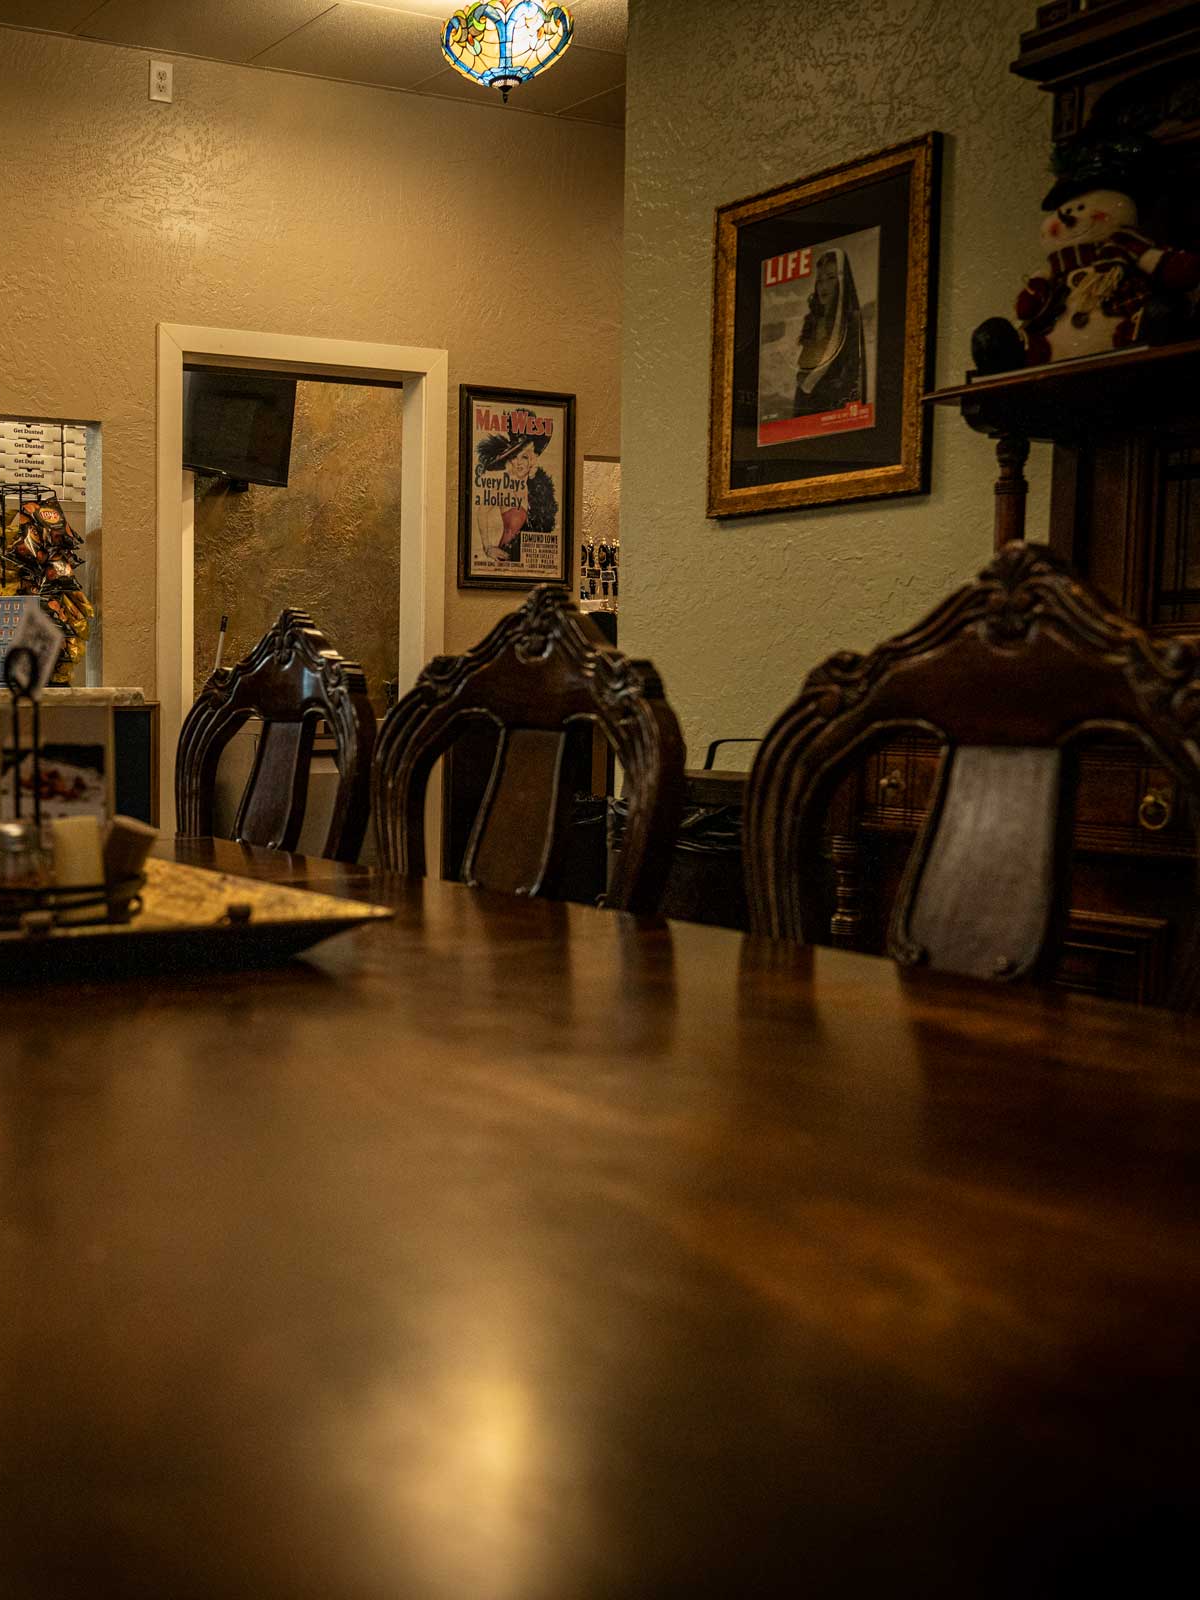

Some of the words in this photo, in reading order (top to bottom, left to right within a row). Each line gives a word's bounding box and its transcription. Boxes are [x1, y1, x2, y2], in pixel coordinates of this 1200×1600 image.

[766, 248, 811, 285] LIFE
[511, 410, 554, 437] WEST
[483, 490, 522, 508] Holiday
